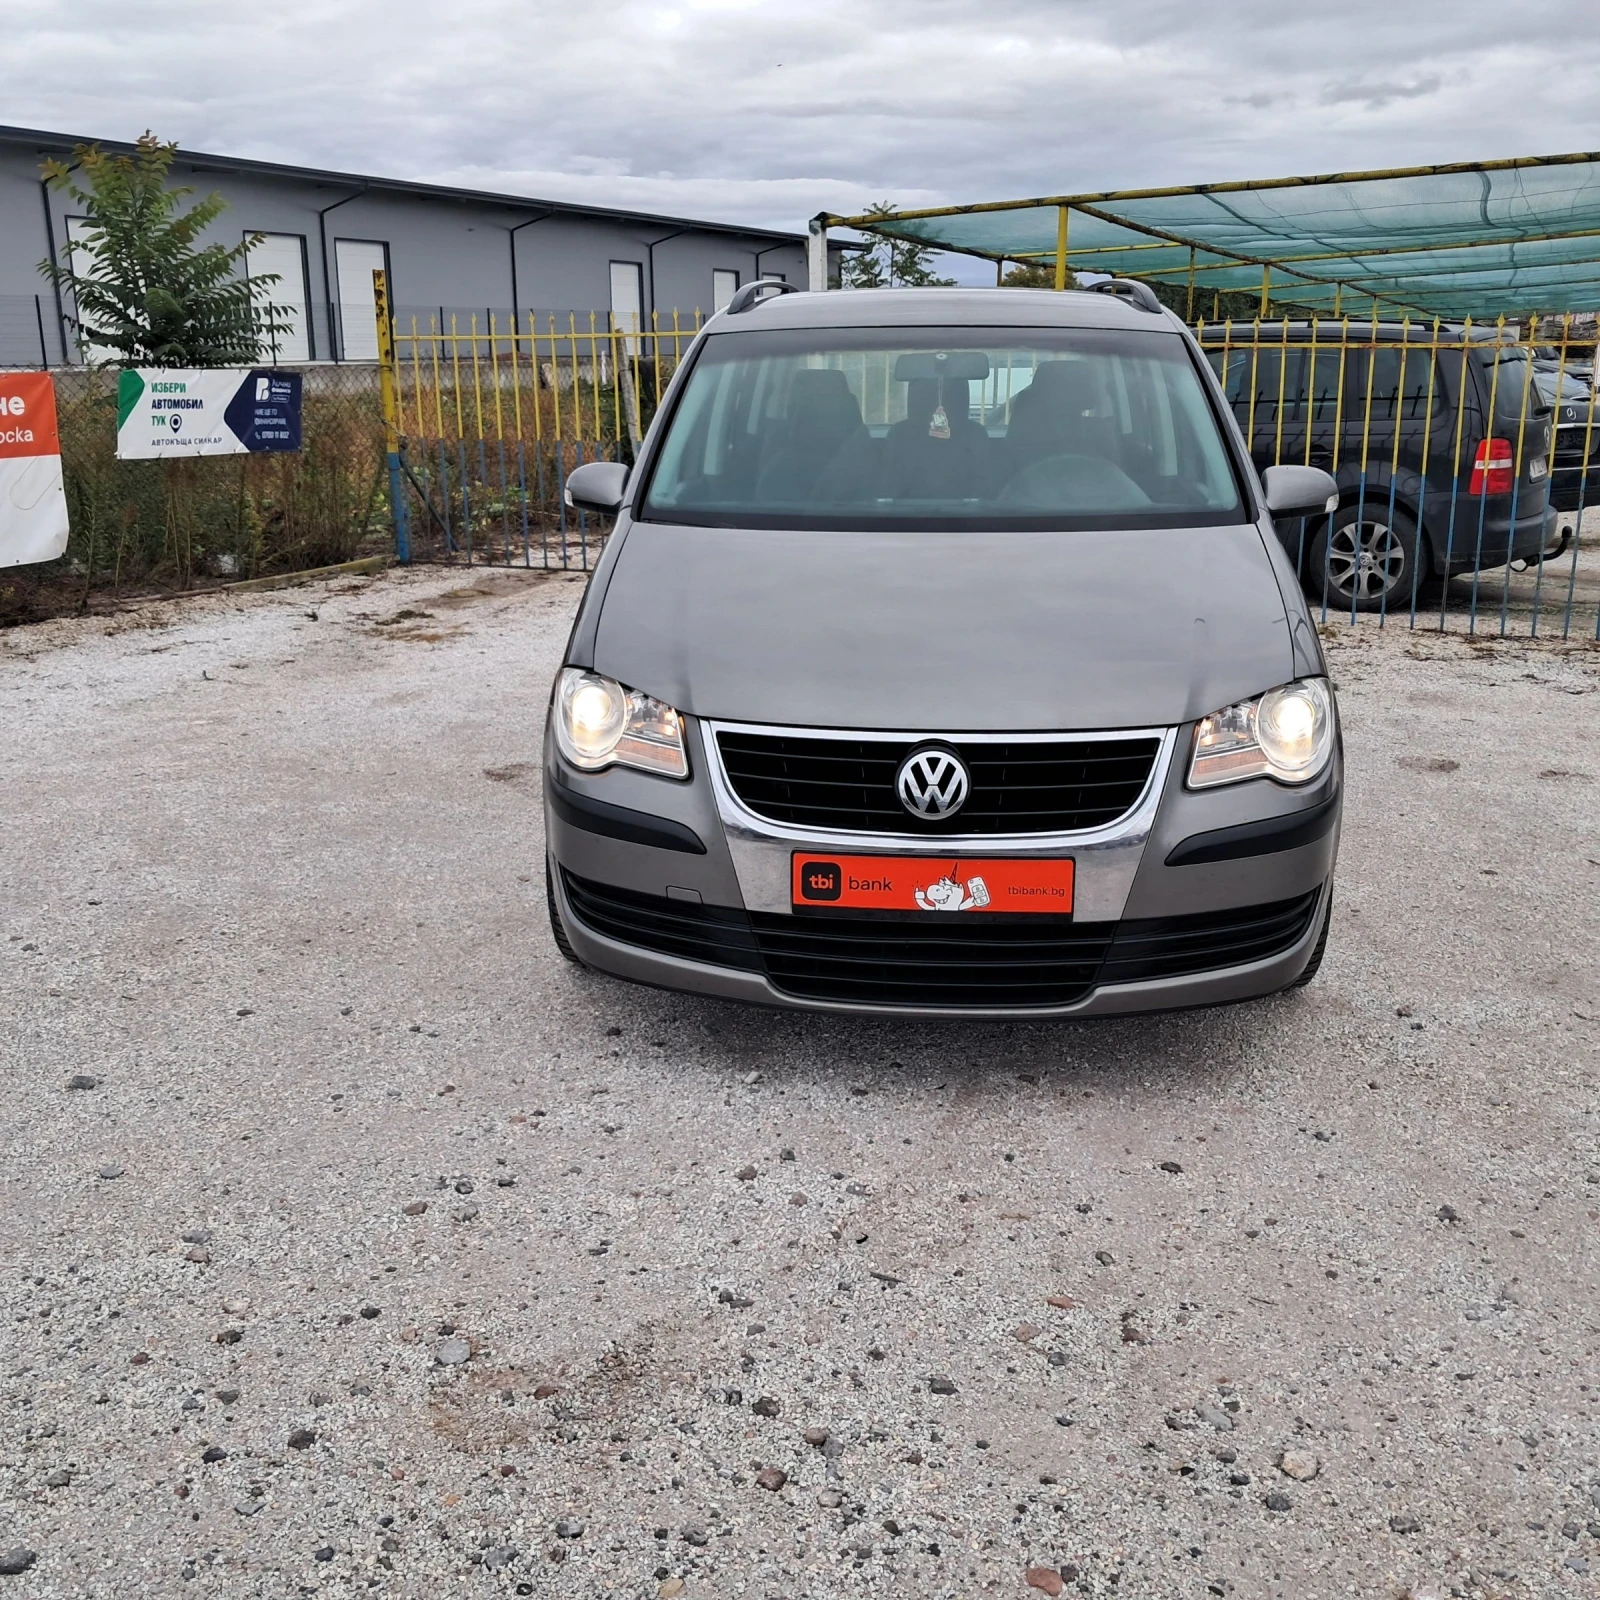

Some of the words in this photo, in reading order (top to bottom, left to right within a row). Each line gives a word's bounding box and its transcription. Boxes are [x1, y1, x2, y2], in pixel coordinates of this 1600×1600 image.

[151, 382, 186, 394] ИЗБЕРИ
[151, 398, 204, 410] АВТОМОБИЛ
[151, 415, 167, 427] ТУК
[151, 438, 192, 447] АВТОКЪЩА
[809, 873, 834, 890] tbi
[848, 875, 893, 892] bank
[1008, 886, 1065, 898] tbibank.bg
